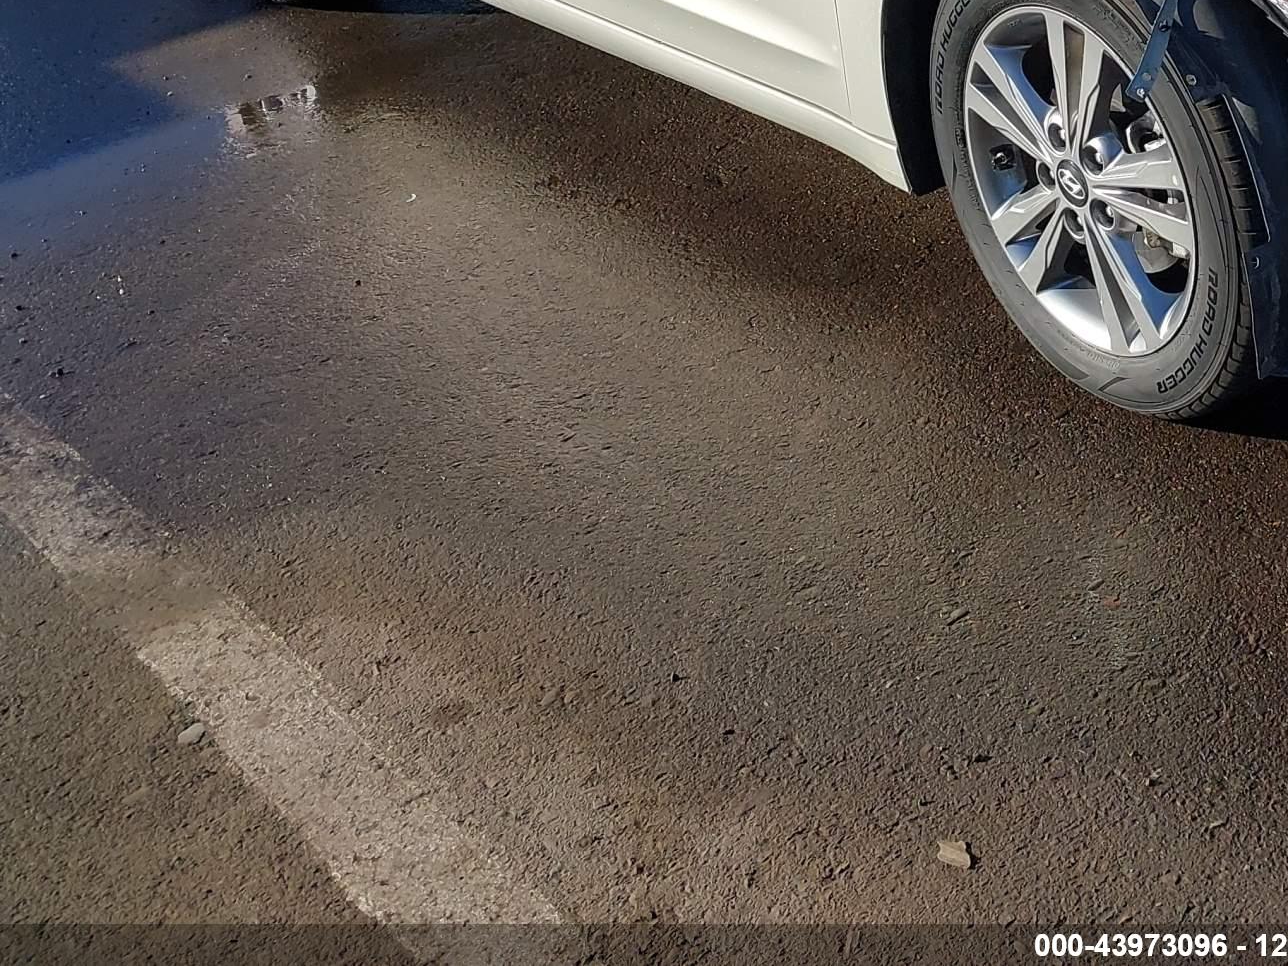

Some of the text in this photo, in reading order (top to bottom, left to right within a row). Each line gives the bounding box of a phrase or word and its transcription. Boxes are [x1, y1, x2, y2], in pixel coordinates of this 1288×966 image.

[934, 51, 945, 114] ROAD
[1156, 266, 1219, 394] ROAD HUGGER
